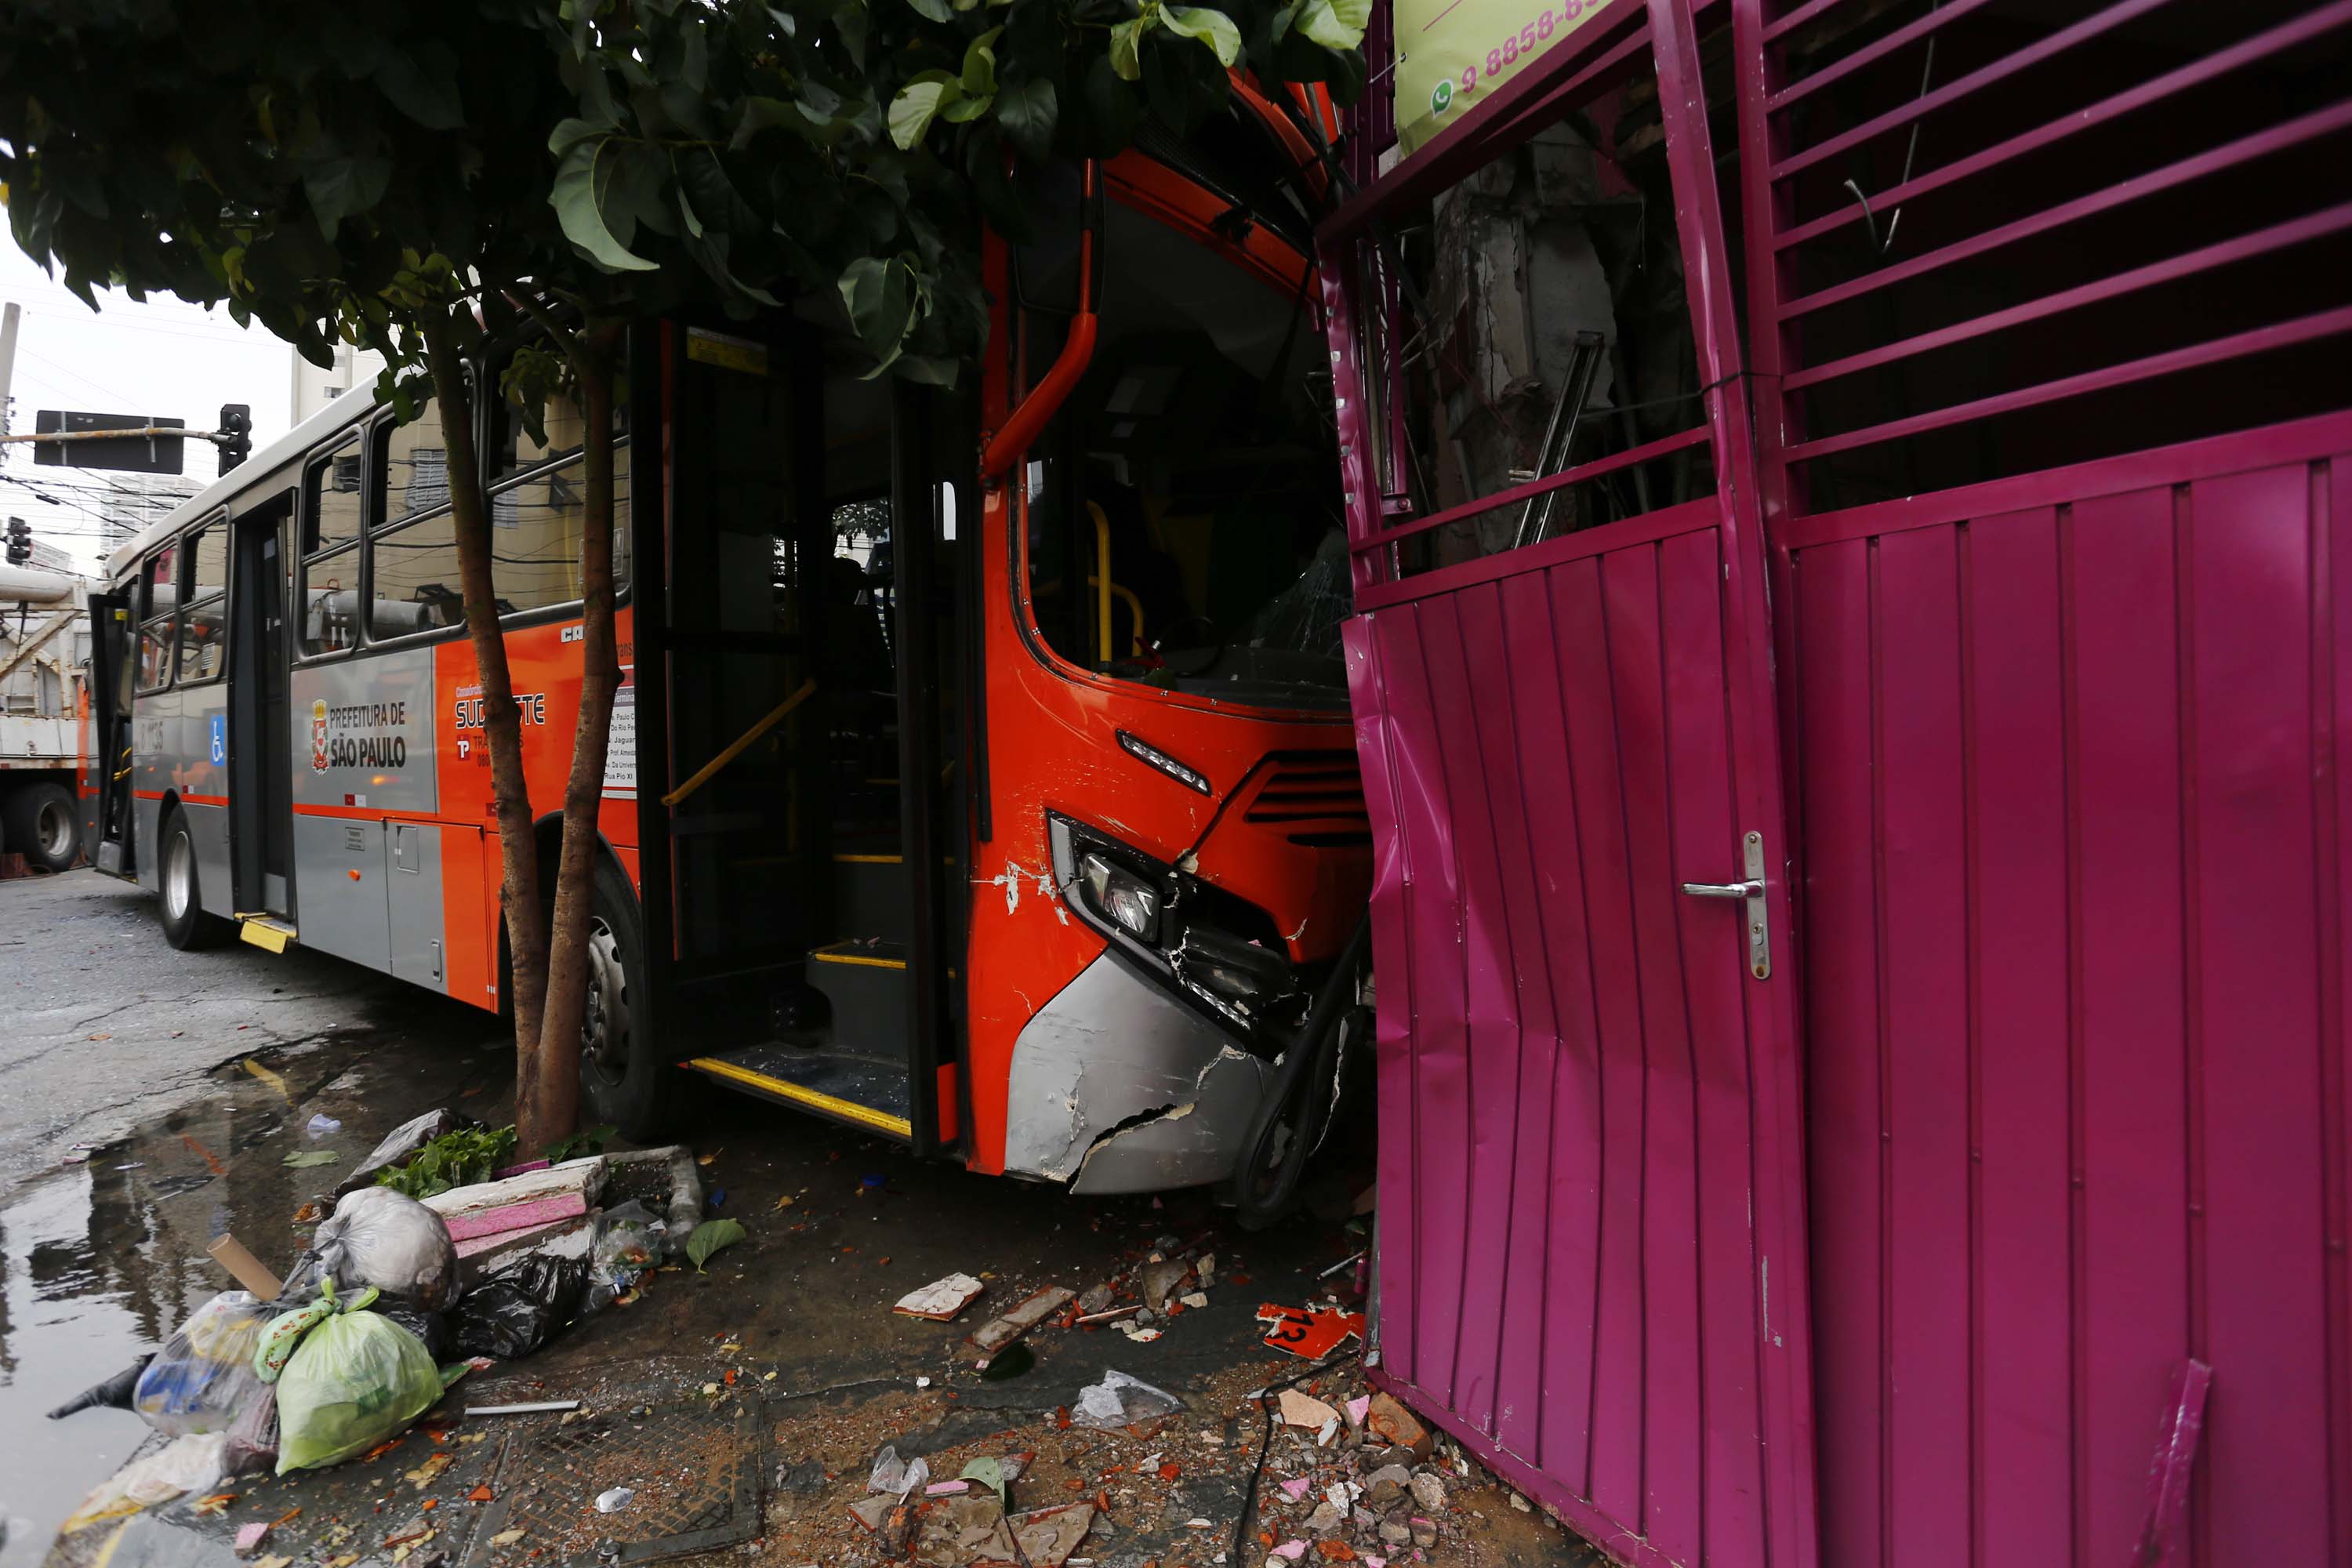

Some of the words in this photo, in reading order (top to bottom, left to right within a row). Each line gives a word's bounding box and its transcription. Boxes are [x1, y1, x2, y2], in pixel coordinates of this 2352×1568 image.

[1461, 66, 1477, 93] 9
[561, 625, 584, 643] CA
[330, 704, 387, 728] PREFEITURA
[390, 702, 405, 725] DE
[456, 693, 545, 729] SUDTE
[331, 732, 357, 768] SÃO
[359, 736, 406, 768] PAULO
